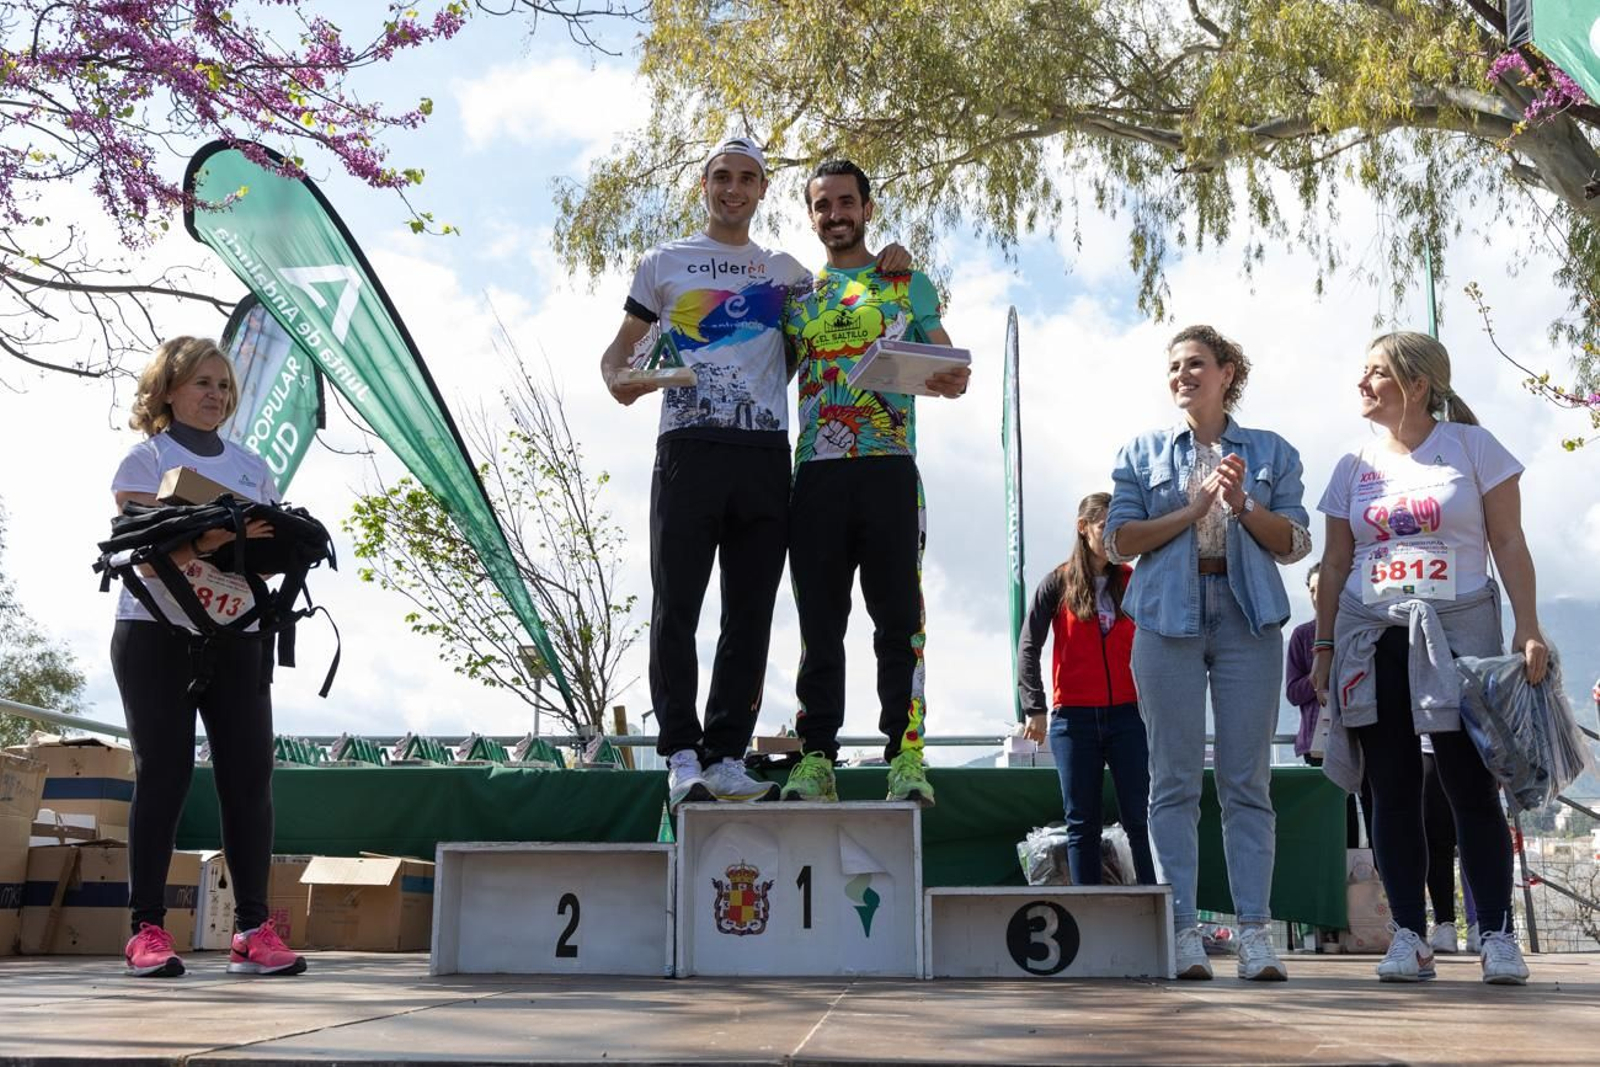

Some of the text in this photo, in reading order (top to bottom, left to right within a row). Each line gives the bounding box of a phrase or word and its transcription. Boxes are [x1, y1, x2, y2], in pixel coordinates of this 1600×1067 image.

[246, 356, 301, 455] POPULAR
[264, 422, 299, 488] UD
[1370, 559, 1448, 584] 5812
[555, 892, 581, 958] 2
[796, 865, 812, 929] 1
[1026, 905, 1061, 971] 3
